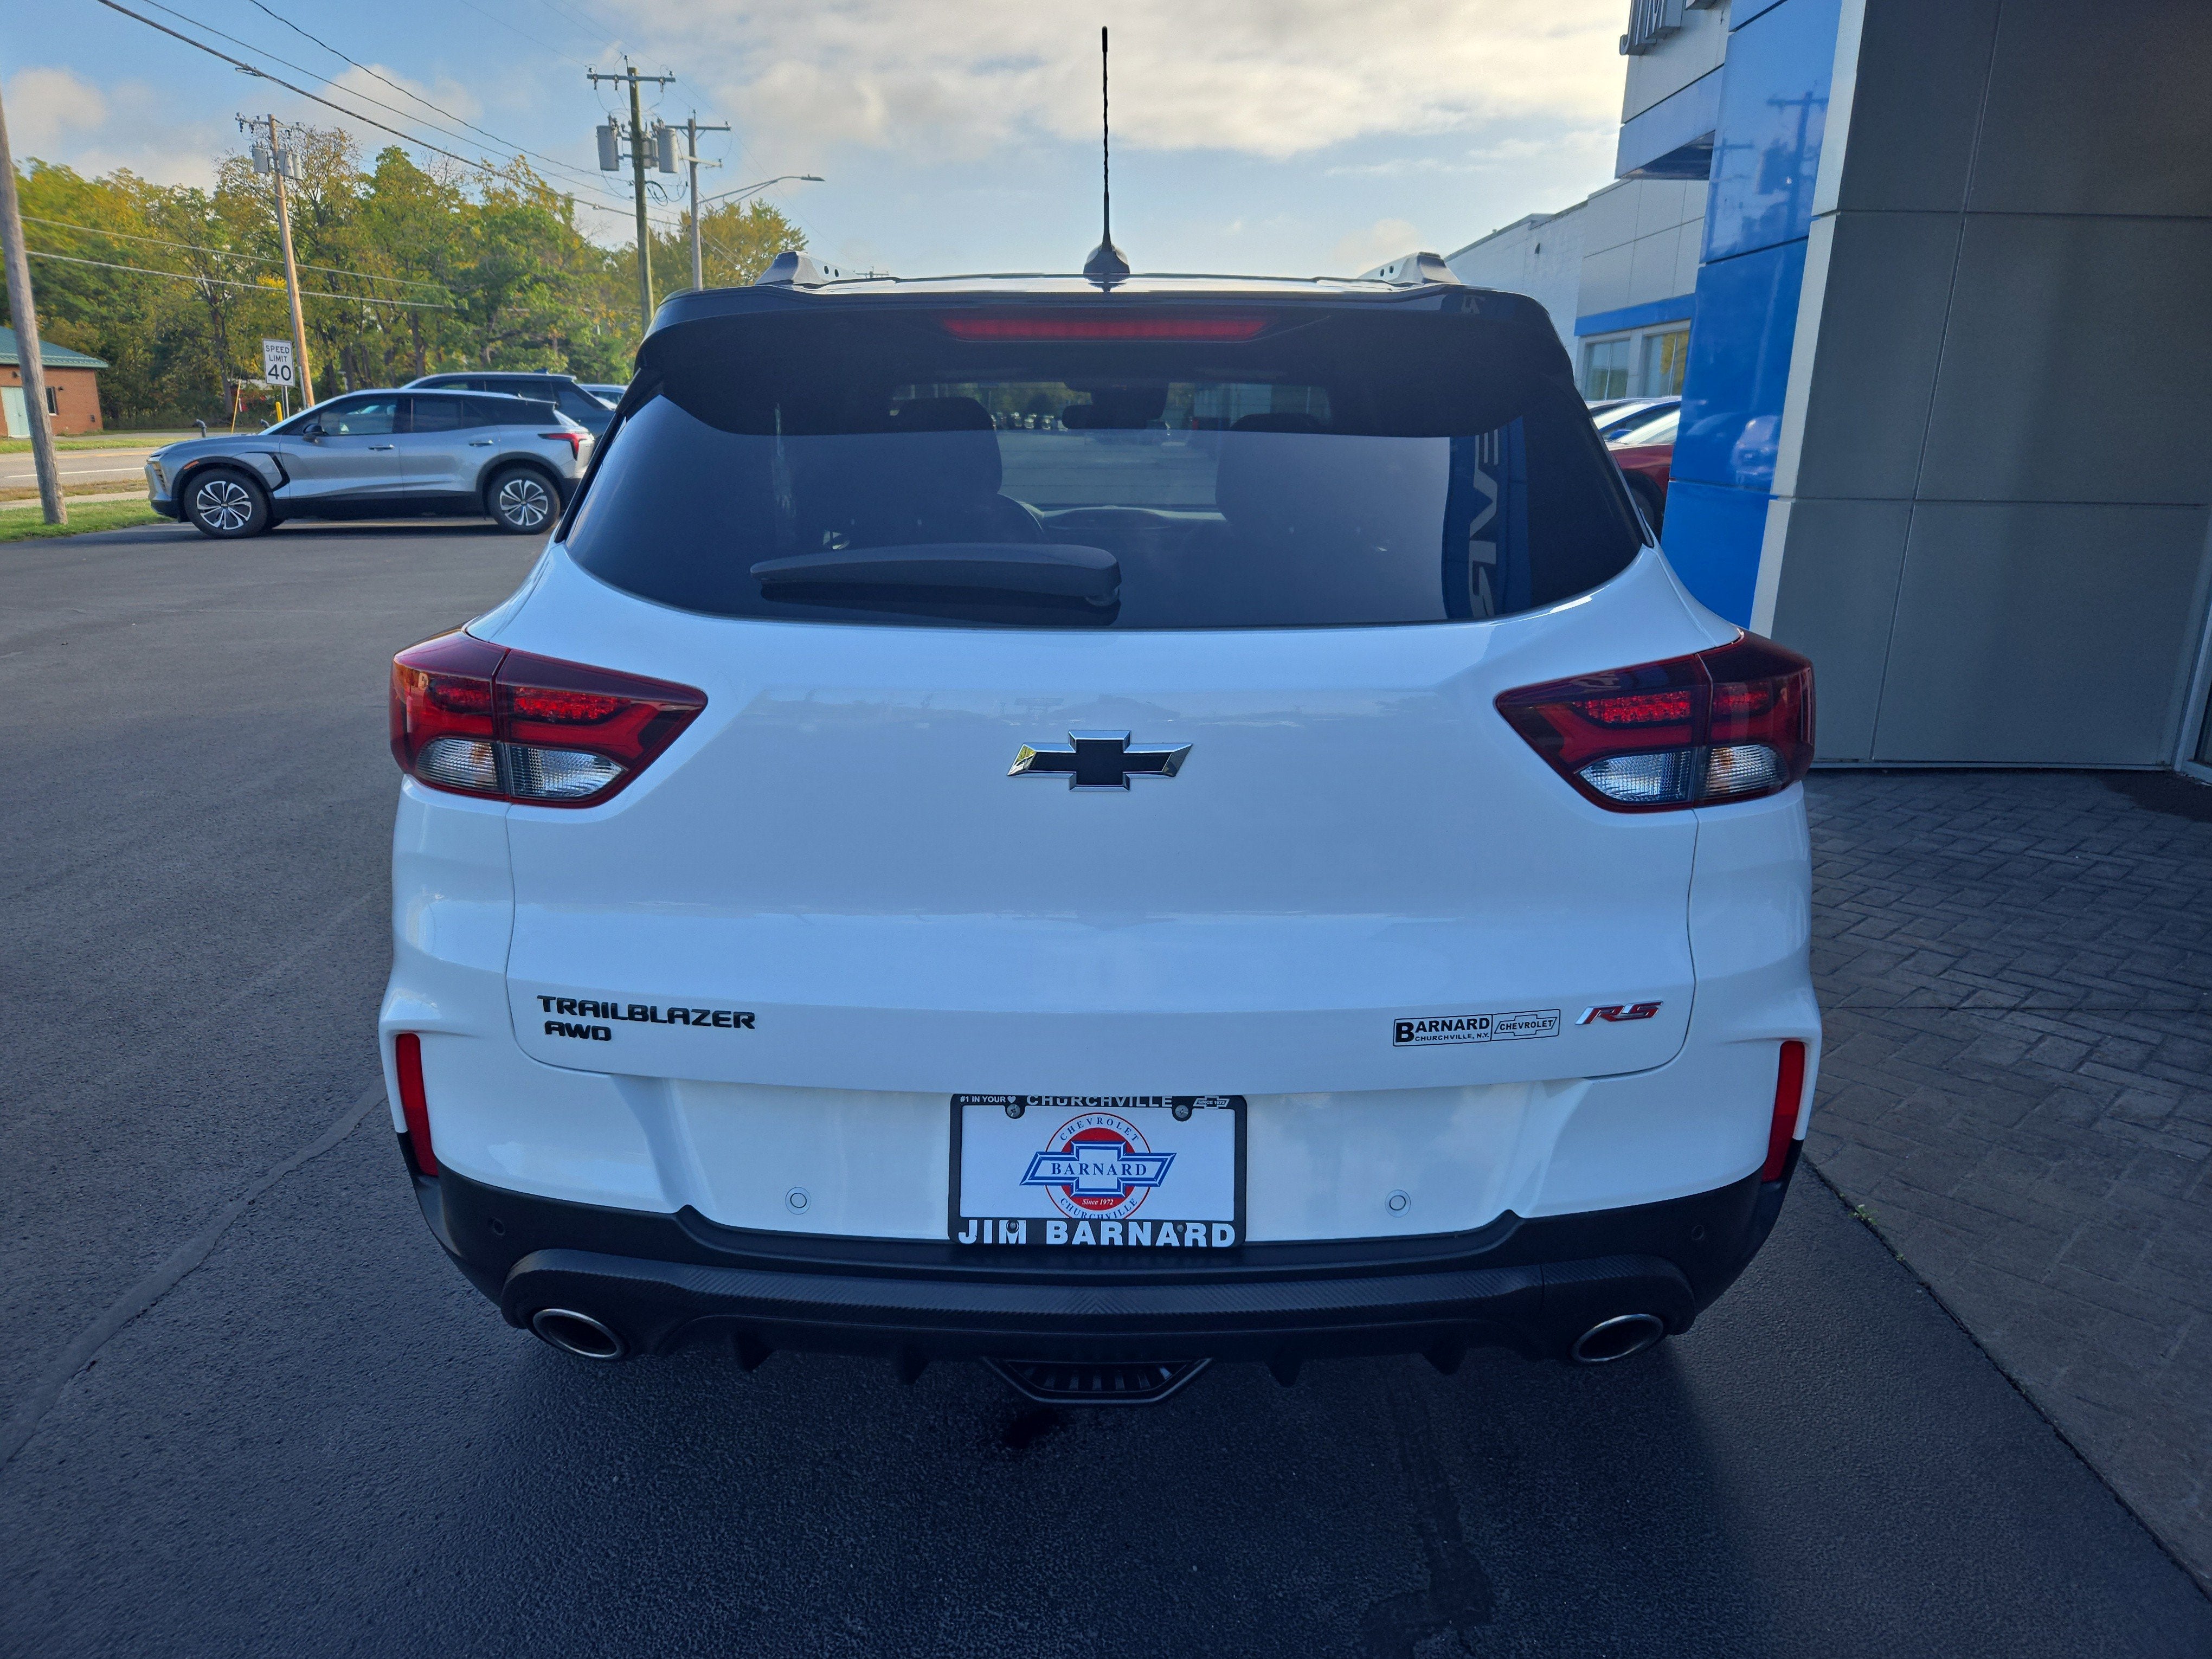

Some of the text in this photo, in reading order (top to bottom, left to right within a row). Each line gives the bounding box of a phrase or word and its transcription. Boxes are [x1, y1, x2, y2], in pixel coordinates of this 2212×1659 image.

[266, 345, 290, 353] SPEED
[269, 354, 287, 362] LIMIT
[268, 364, 291, 381] 40
[537, 995, 755, 1029] TRAILBLAZER
[1575, 1001, 1663, 1025] RS
[544, 1020, 612, 1041] AWD
[1395, 1017, 1490, 1043] BARNARD
[1499, 1019, 1553, 1031] CHEVROLET
[1026, 1095, 1172, 1107] CHURCHVILLE
[1060, 1117, 1139, 1141] CHEVROLET
[1051, 1163, 1147, 1176] BARNARD
[1060, 1197, 1138, 1219] CHURCHVILLE
[957, 1219, 1236, 1248] JIM BARNARD
